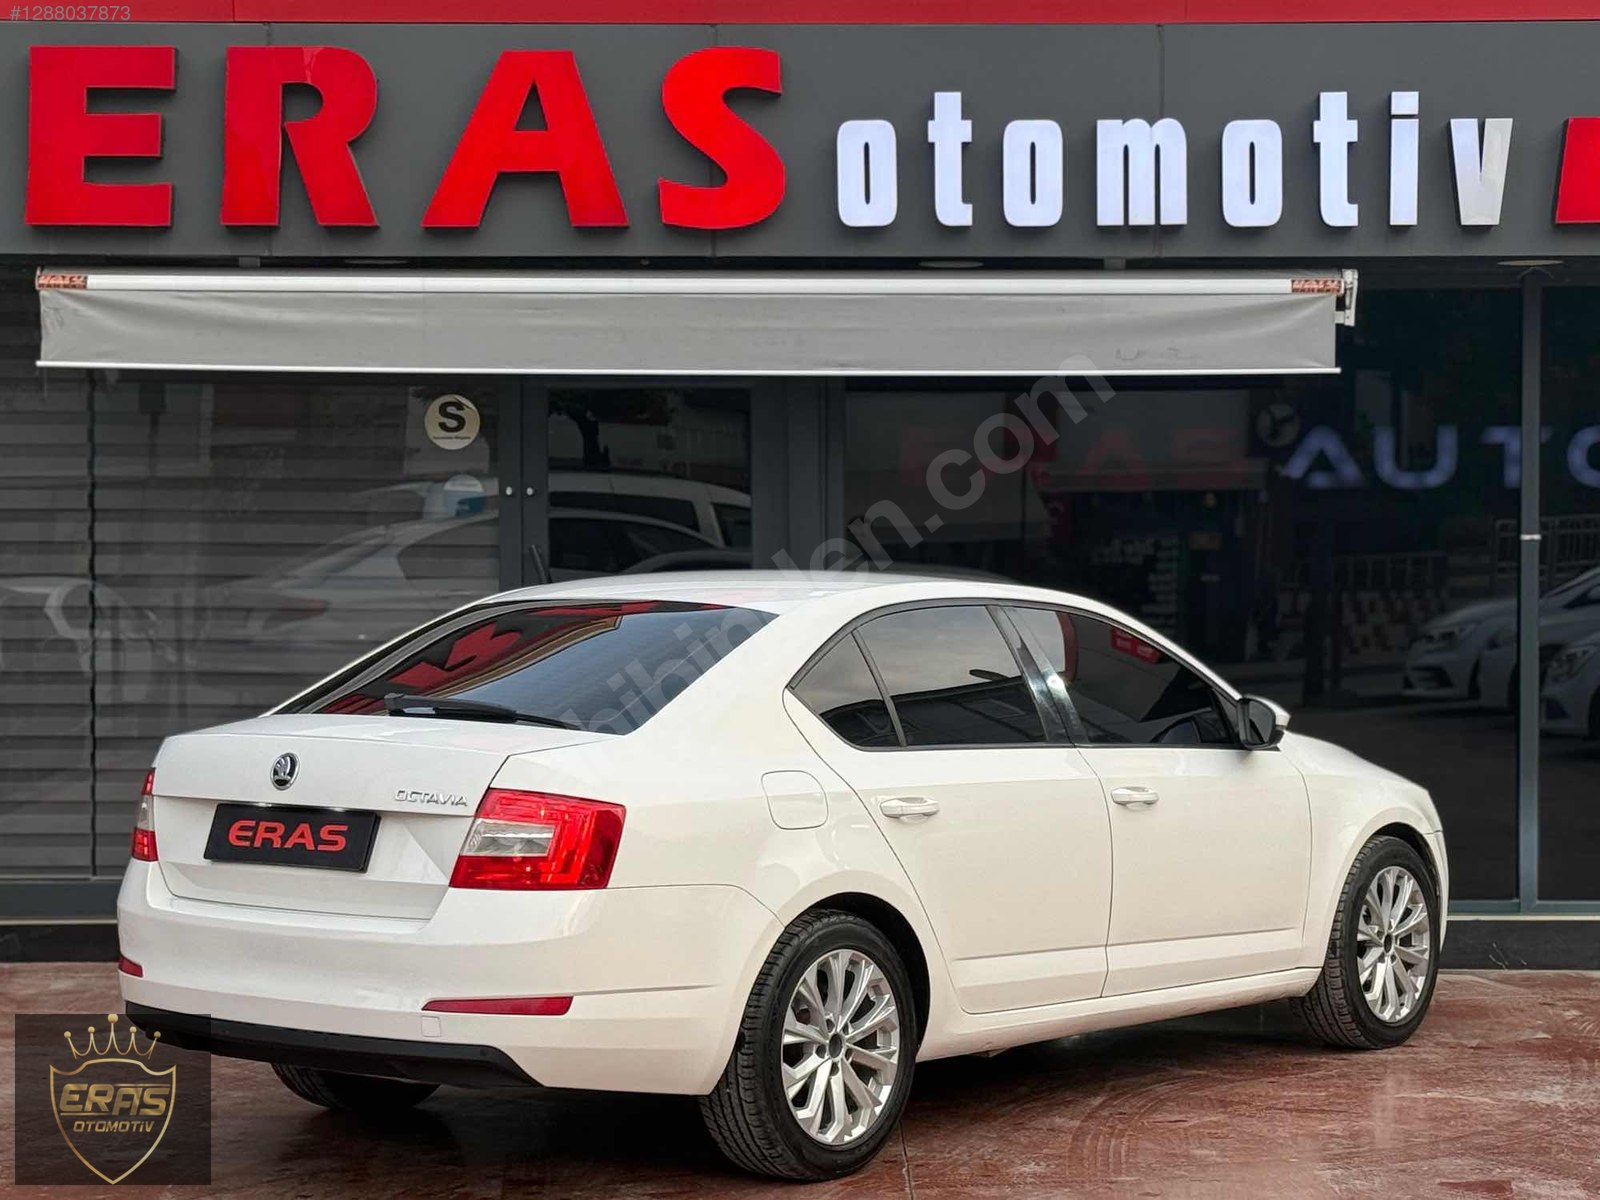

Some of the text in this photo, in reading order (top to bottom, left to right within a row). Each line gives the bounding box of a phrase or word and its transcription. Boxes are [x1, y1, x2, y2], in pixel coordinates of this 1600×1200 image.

[25, 46, 787, 229] ERAS
[836, 91, 1513, 227] otomotiv
[438, 401, 466, 433] S
[395, 788, 468, 807] OCTAVIA
[228, 820, 349, 852] ERAS
